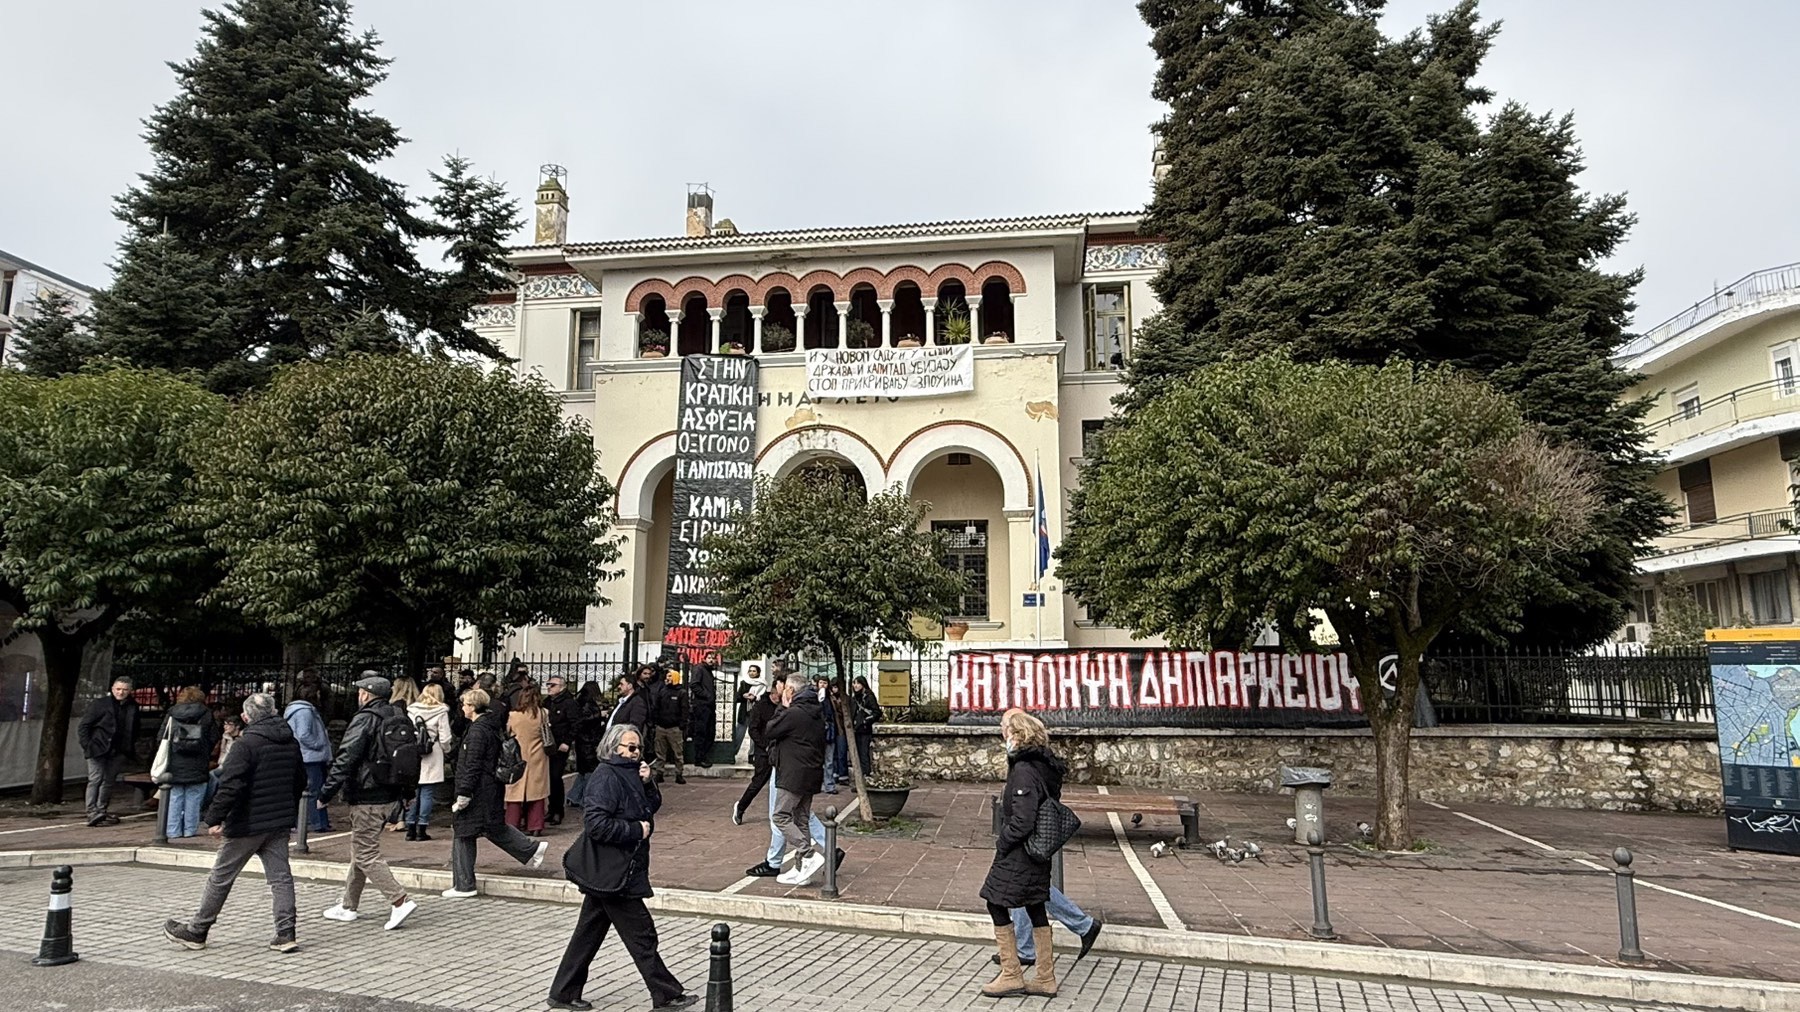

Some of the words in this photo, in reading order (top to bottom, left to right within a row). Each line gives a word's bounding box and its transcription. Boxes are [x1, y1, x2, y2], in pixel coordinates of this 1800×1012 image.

[697, 357, 746, 379] ΣΤΗΝ
[685, 381, 754, 407] ΚΡΑΤΙΚΗ
[681, 407, 757, 432] ΑΣΦΥΞΙΑ
[678, 431, 750, 454] ΟΞΥΓΟΝΟ
[676, 458, 685, 480] Η
[687, 460, 754, 480] ΑΝΤΙΣΤΑΣΗ
[949, 652, 1132, 710] ΚΑΤΑΛΗΨΗ
[1138, 650, 1365, 711] ΔΗΜΑΡΧΕΙΟΥ
